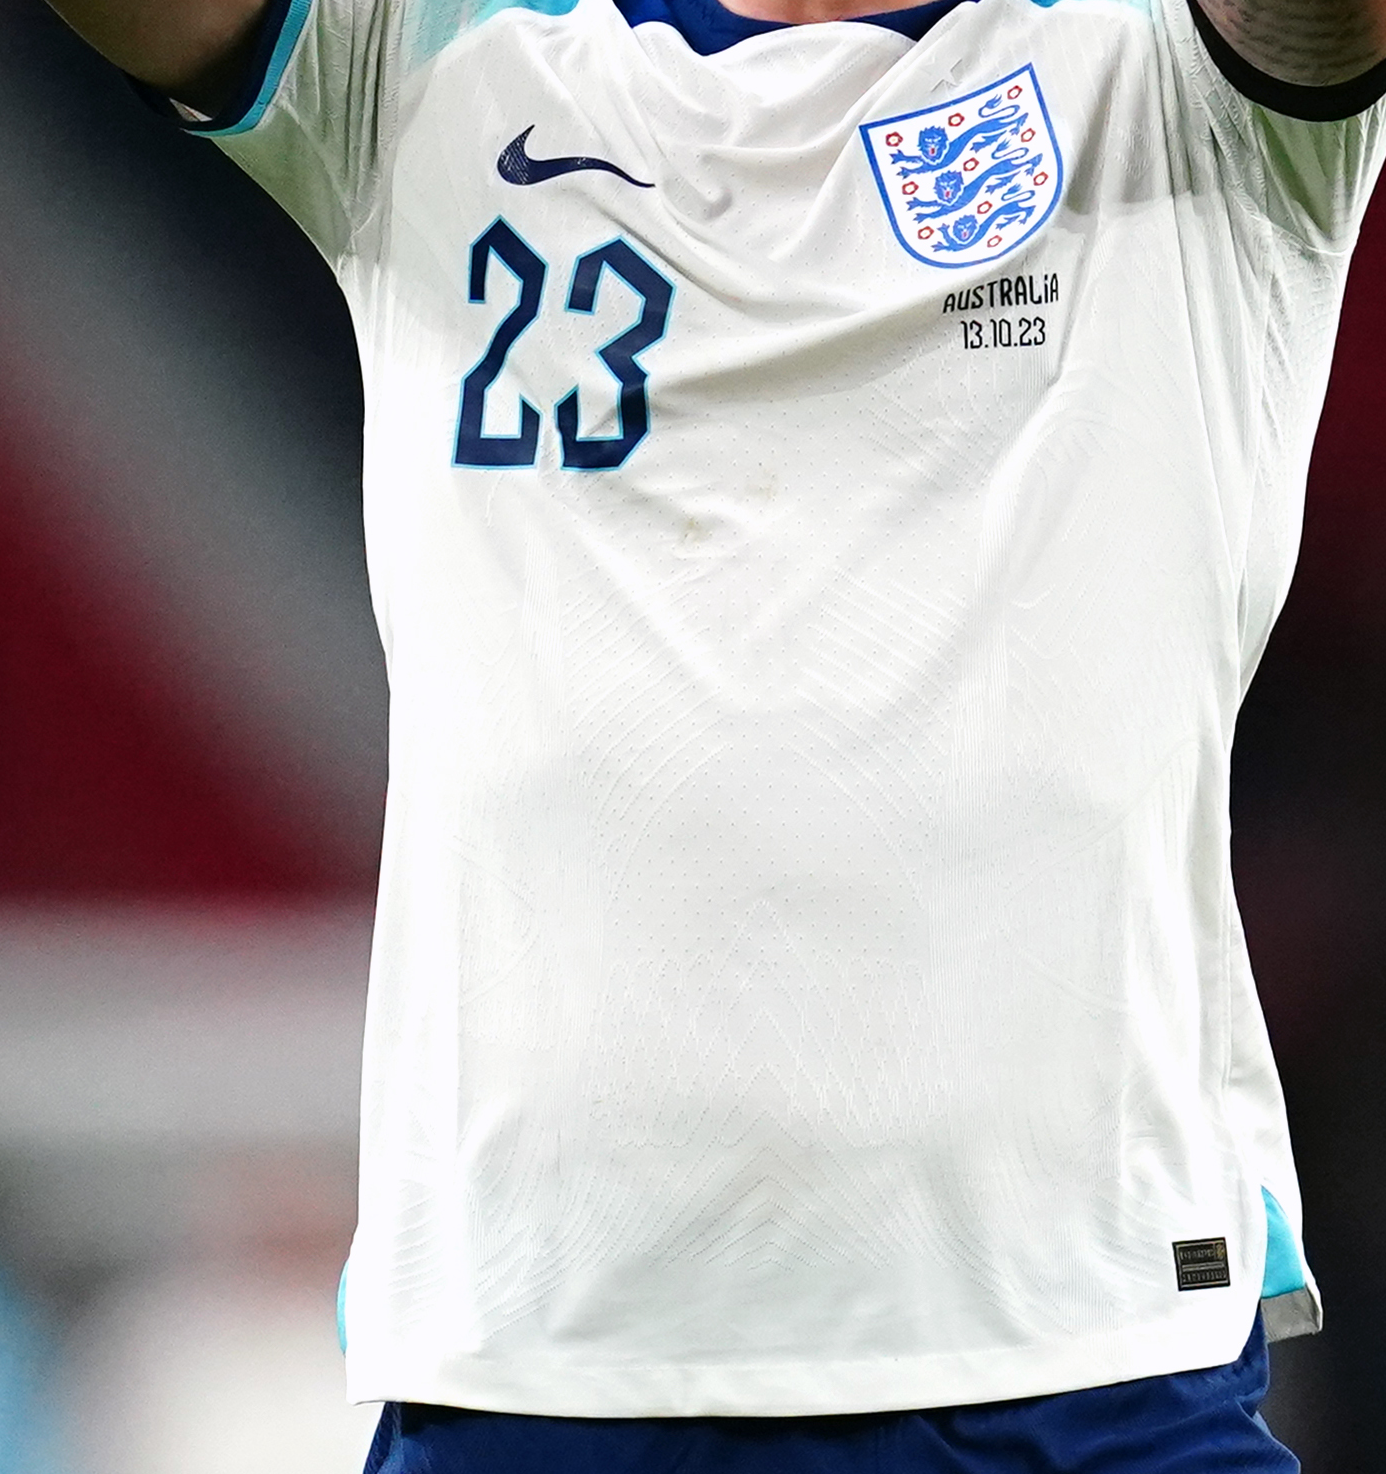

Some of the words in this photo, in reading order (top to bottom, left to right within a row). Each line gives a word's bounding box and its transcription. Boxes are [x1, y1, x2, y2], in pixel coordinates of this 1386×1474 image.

[942, 273, 1059, 314] AUSTRALIA
[451, 214, 676, 472] 23
[960, 316, 1046, 350] 13.10.23
